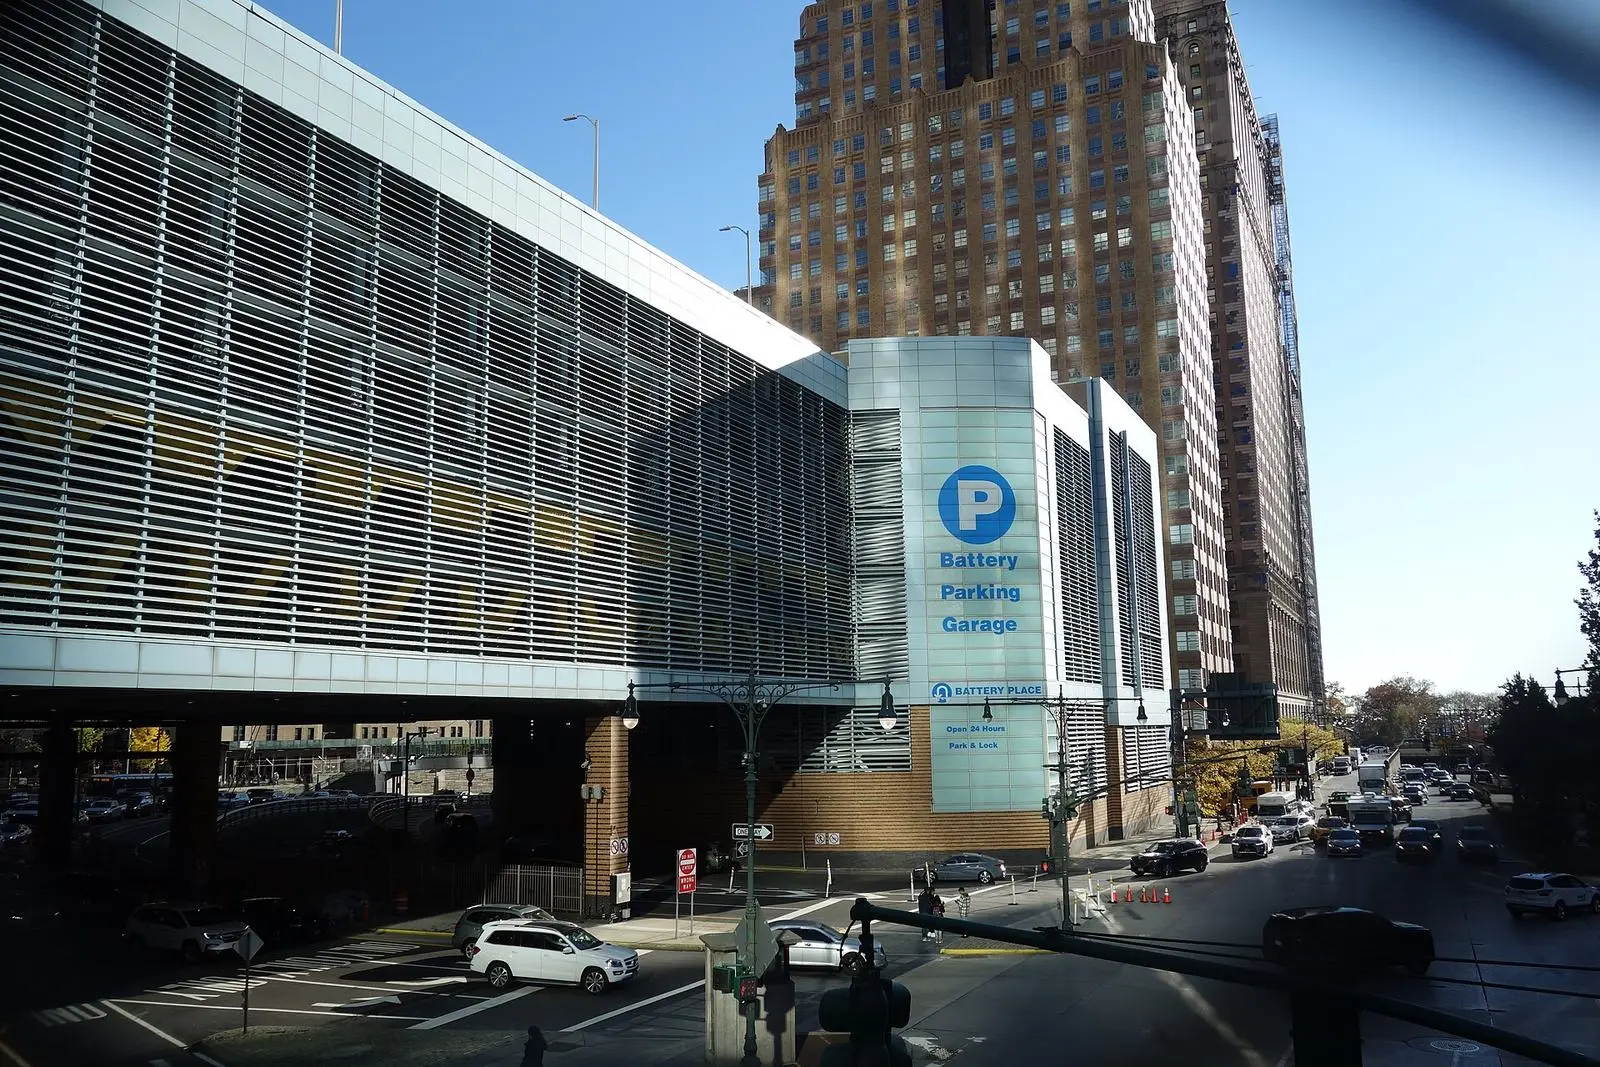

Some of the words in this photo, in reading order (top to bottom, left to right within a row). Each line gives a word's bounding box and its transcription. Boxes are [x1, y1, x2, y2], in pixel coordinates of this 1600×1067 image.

[957, 479, 1004, 532] P
[940, 551, 1018, 571] Battery
[941, 583, 1021, 602] Parking
[942, 616, 1018, 635] Garage
[955, 687, 1005, 695] BATTERY
[1008, 685, 1042, 695] PLACE
[946, 726, 968, 734] Open
[970, 725, 980, 733] 24
[982, 725, 1005, 733] Hours
[949, 742, 968, 750] Park
